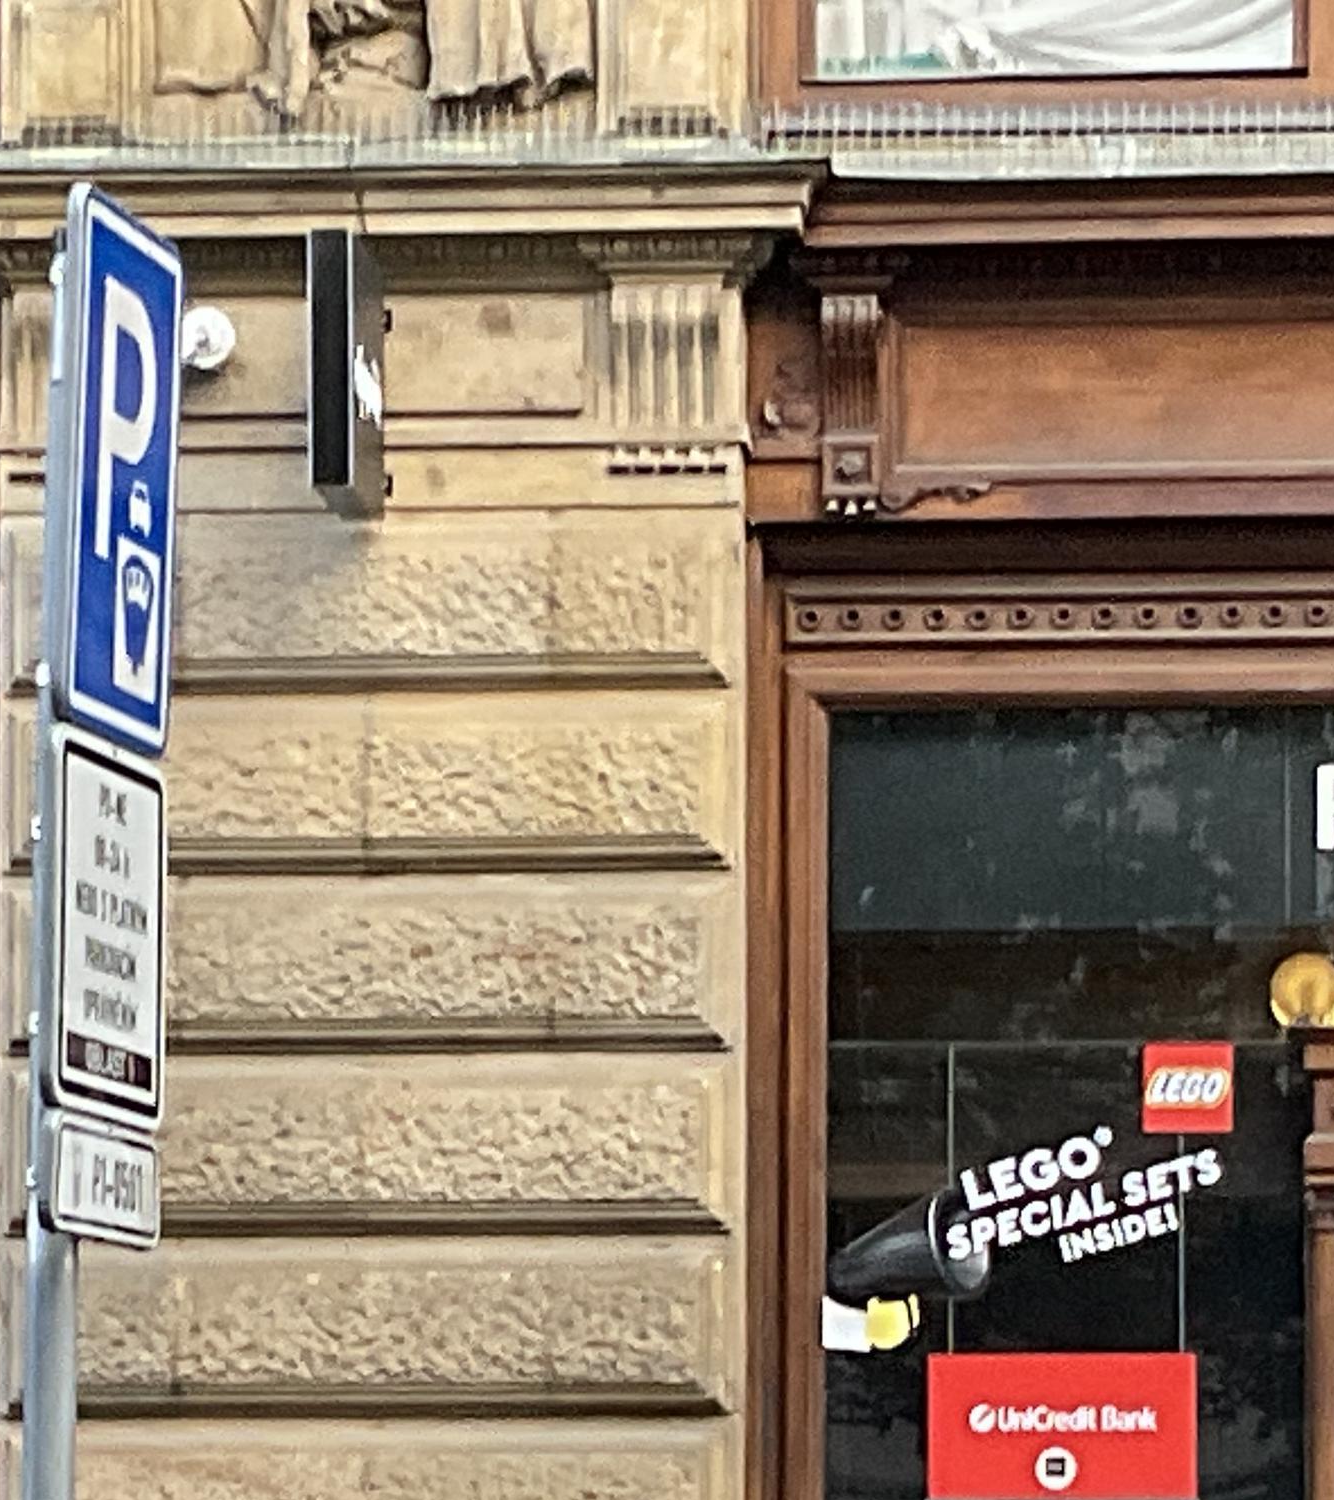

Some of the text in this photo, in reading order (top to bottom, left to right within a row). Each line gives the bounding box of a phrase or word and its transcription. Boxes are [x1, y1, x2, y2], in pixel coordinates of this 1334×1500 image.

[94, 274, 158, 559] P
[1149, 1070, 1225, 1105] LEGO
[946, 1149, 1222, 1260] SPECIAL SETS
[1058, 1203, 1180, 1264] INSIDE!
[997, 1405, 1157, 1432] UniCredit Bank
